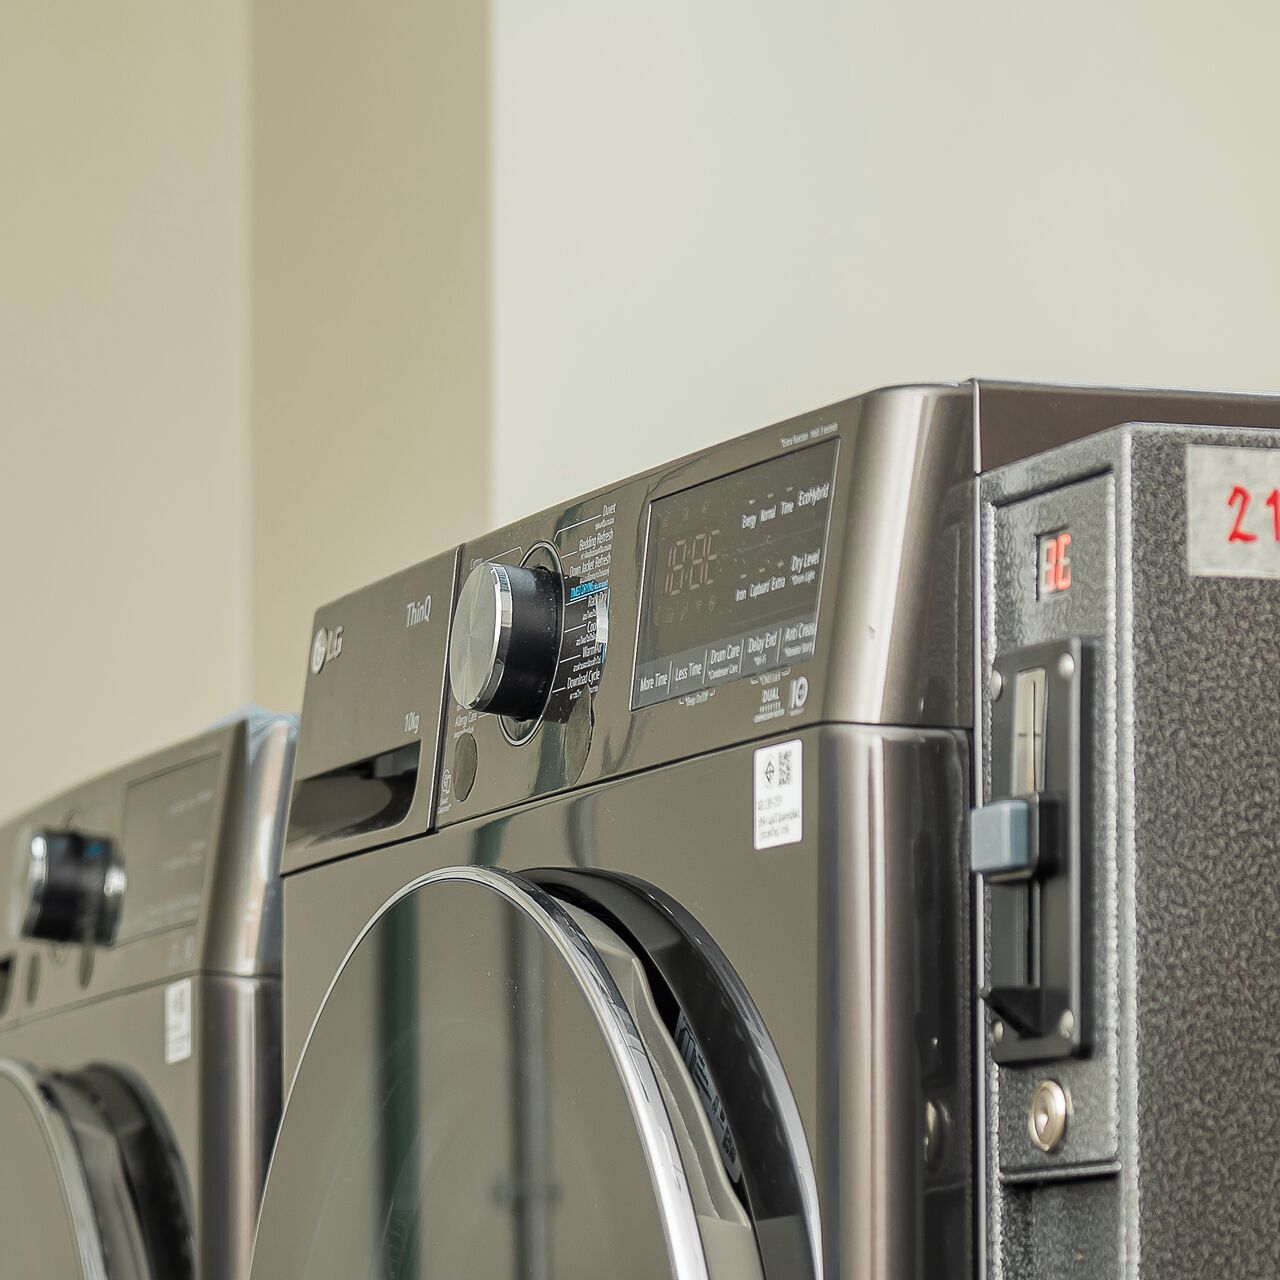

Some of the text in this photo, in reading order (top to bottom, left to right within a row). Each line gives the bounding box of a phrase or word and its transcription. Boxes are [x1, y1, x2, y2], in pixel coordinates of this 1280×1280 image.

[798, 482, 829, 507] EcoHybrid
[603, 502, 616, 517] Duvet
[760, 505, 776, 522] Normal
[781, 500, 794, 515] Time
[596, 527, 614, 545] Refresh
[791, 548, 821, 573] Dry Level
[736, 588, 747, 601] Iron
[770, 575, 786, 591] Extra
[406, 595, 431, 628] ThinQ
[326, 625, 344, 662] LG
[710, 643, 740, 665] Drum Care
[748, 633, 777, 655] Delay End
[567, 667, 600, 689] Download Cycle
[639, 672, 668, 692] More Time
[675, 662, 702, 682] Less Time
[761, 687, 780, 703] DUAL
[789, 675, 809, 709] 10
[404, 711, 420, 734] 10kg
